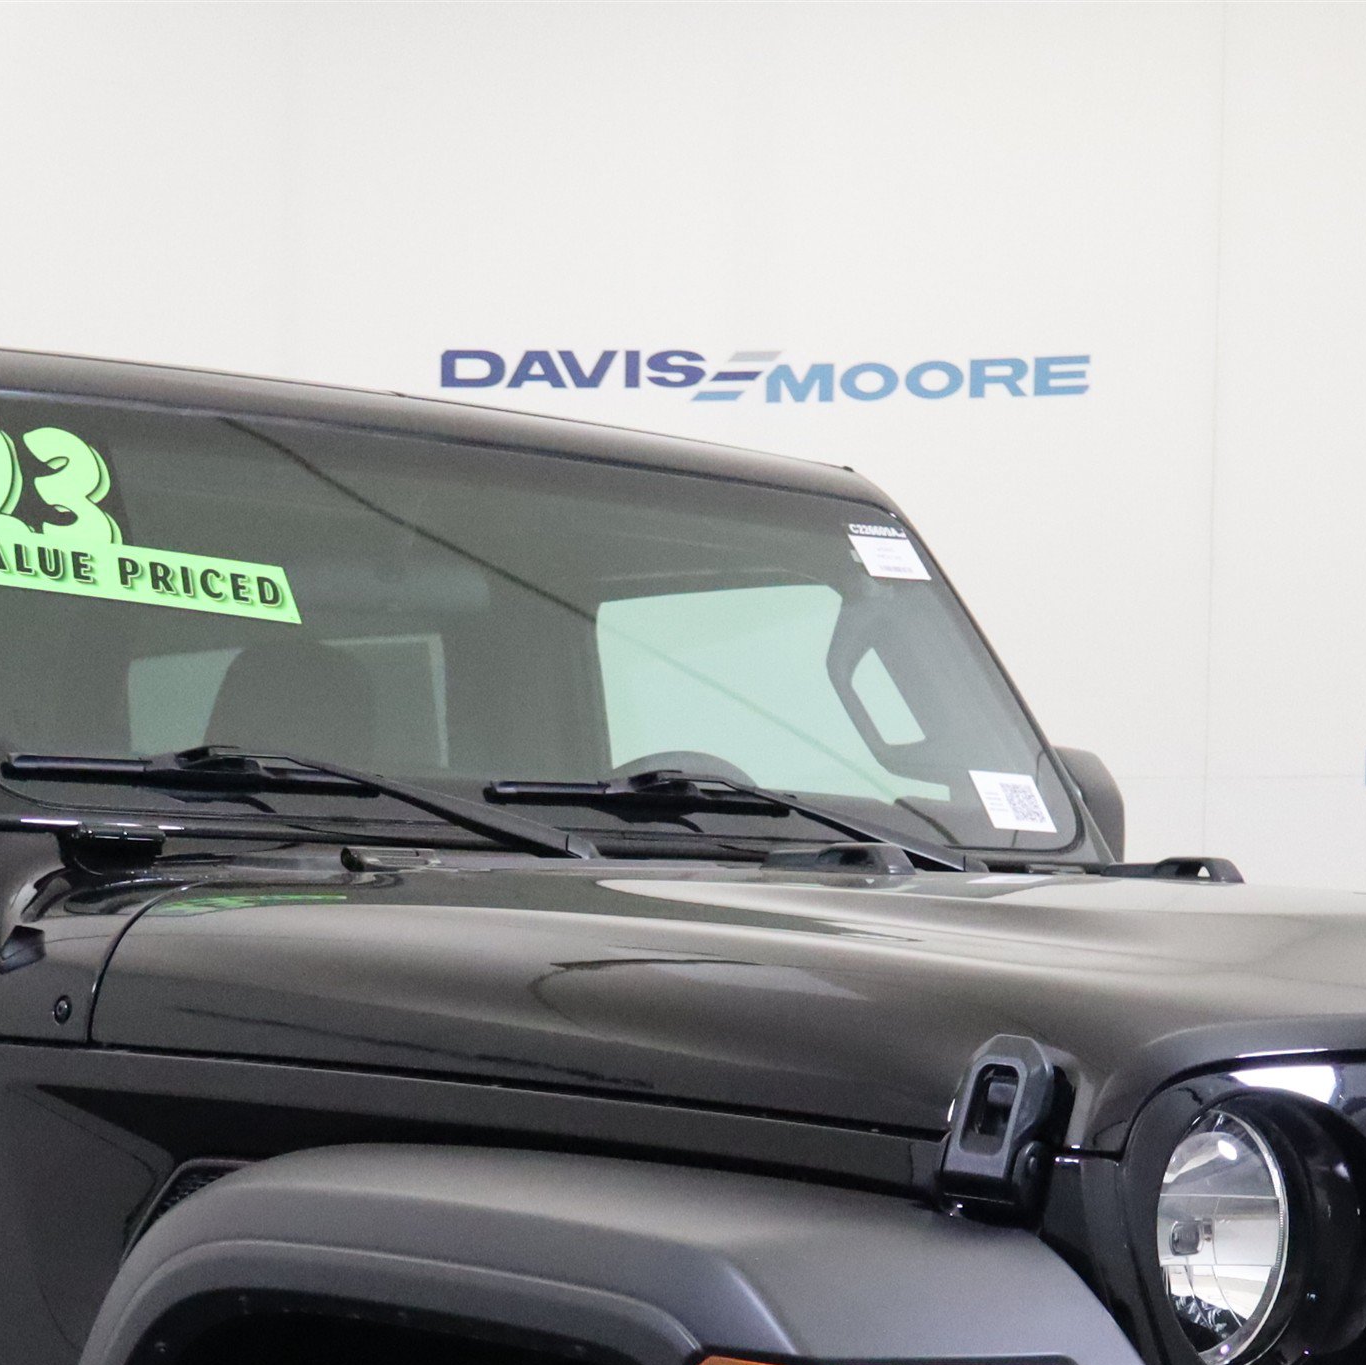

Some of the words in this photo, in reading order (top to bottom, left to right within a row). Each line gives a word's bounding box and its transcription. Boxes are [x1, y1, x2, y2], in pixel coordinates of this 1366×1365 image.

[440, 349, 706, 389] DAVIS
[765, 355, 1090, 403] MOORE
[117, 556, 285, 607] PRICED
